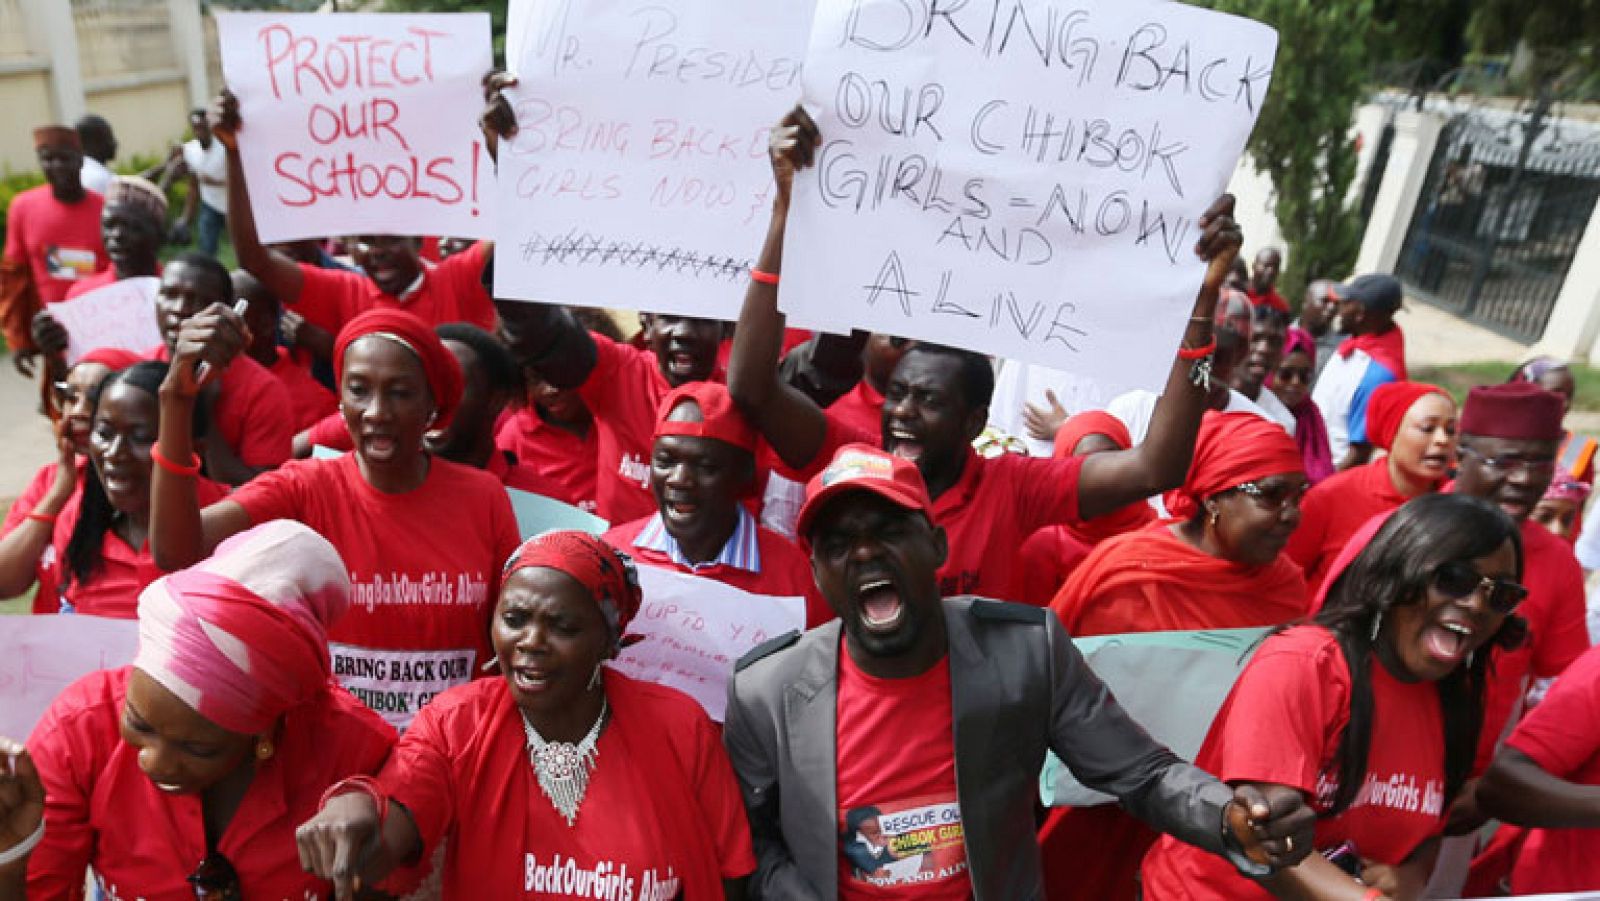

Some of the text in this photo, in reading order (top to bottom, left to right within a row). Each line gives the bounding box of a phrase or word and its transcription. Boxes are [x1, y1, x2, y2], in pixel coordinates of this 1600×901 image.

[259, 25, 452, 98] PROTECT
[623, 6, 803, 90] PRESIDEN
[1116, 23, 1272, 113] BACK
[308, 99, 408, 151] OUR
[512, 98, 632, 154] BRING
[650, 119, 743, 160] BACK
[836, 72, 1189, 198] OUR CHIBOK
[516, 166, 624, 200] GIRLS
[650, 176, 736, 208] NOW
[936, 216, 1053, 266] AND
[863, 250, 1089, 353] ALIVE
[334, 654, 468, 682] BRING BACK OUR
[883, 808, 961, 831] RESCUE OU
[889, 829, 936, 852] CHIBOK
